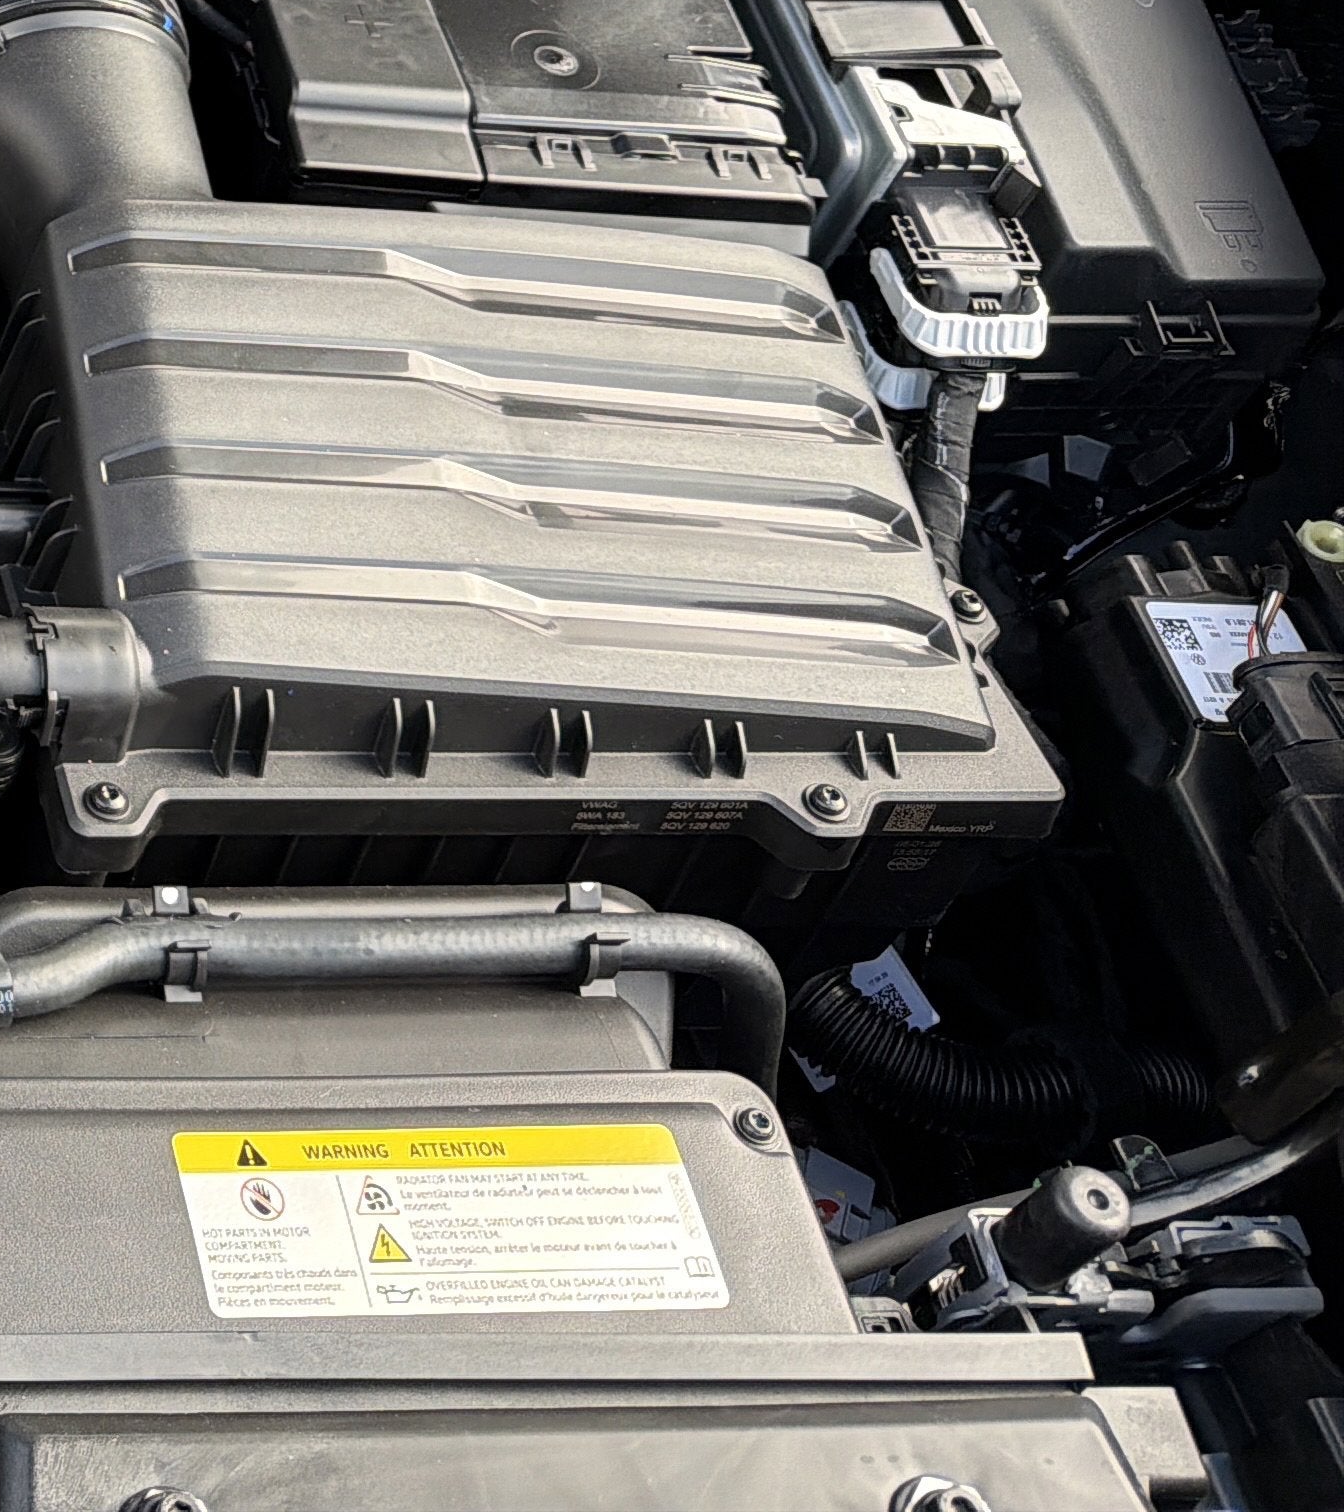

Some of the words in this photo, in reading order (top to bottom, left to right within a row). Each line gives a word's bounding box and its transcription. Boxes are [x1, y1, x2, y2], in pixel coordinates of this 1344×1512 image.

[302, 1144, 389, 1159] WARNING
[410, 1141, 506, 1157] ATTENTION
[202, 1229, 223, 1238] HOT
